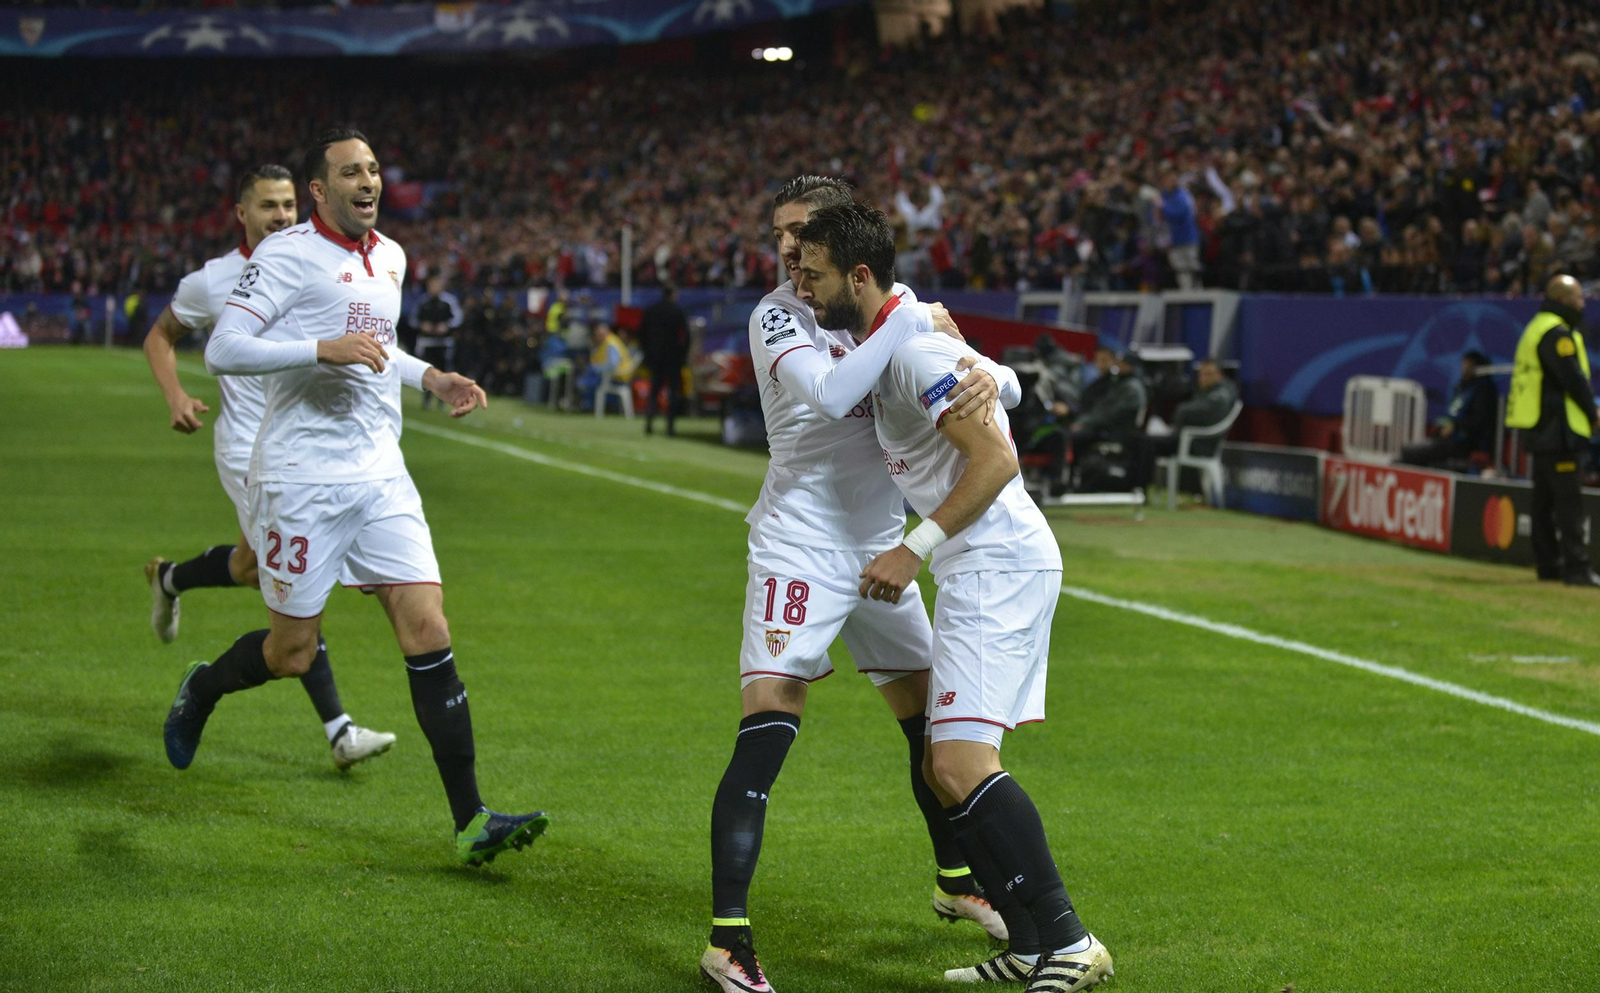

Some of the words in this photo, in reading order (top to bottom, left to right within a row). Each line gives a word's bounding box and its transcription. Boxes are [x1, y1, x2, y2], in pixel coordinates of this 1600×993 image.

[348, 302, 371, 316] SEE
[346, 316, 393, 332] PUERTO
[927, 376, 958, 401] RESPECT
[1347, 465, 1445, 544] UniCredit
[266, 530, 309, 575] 23
[763, 577, 810, 626] 18
[1005, 874, 1025, 892] FC
